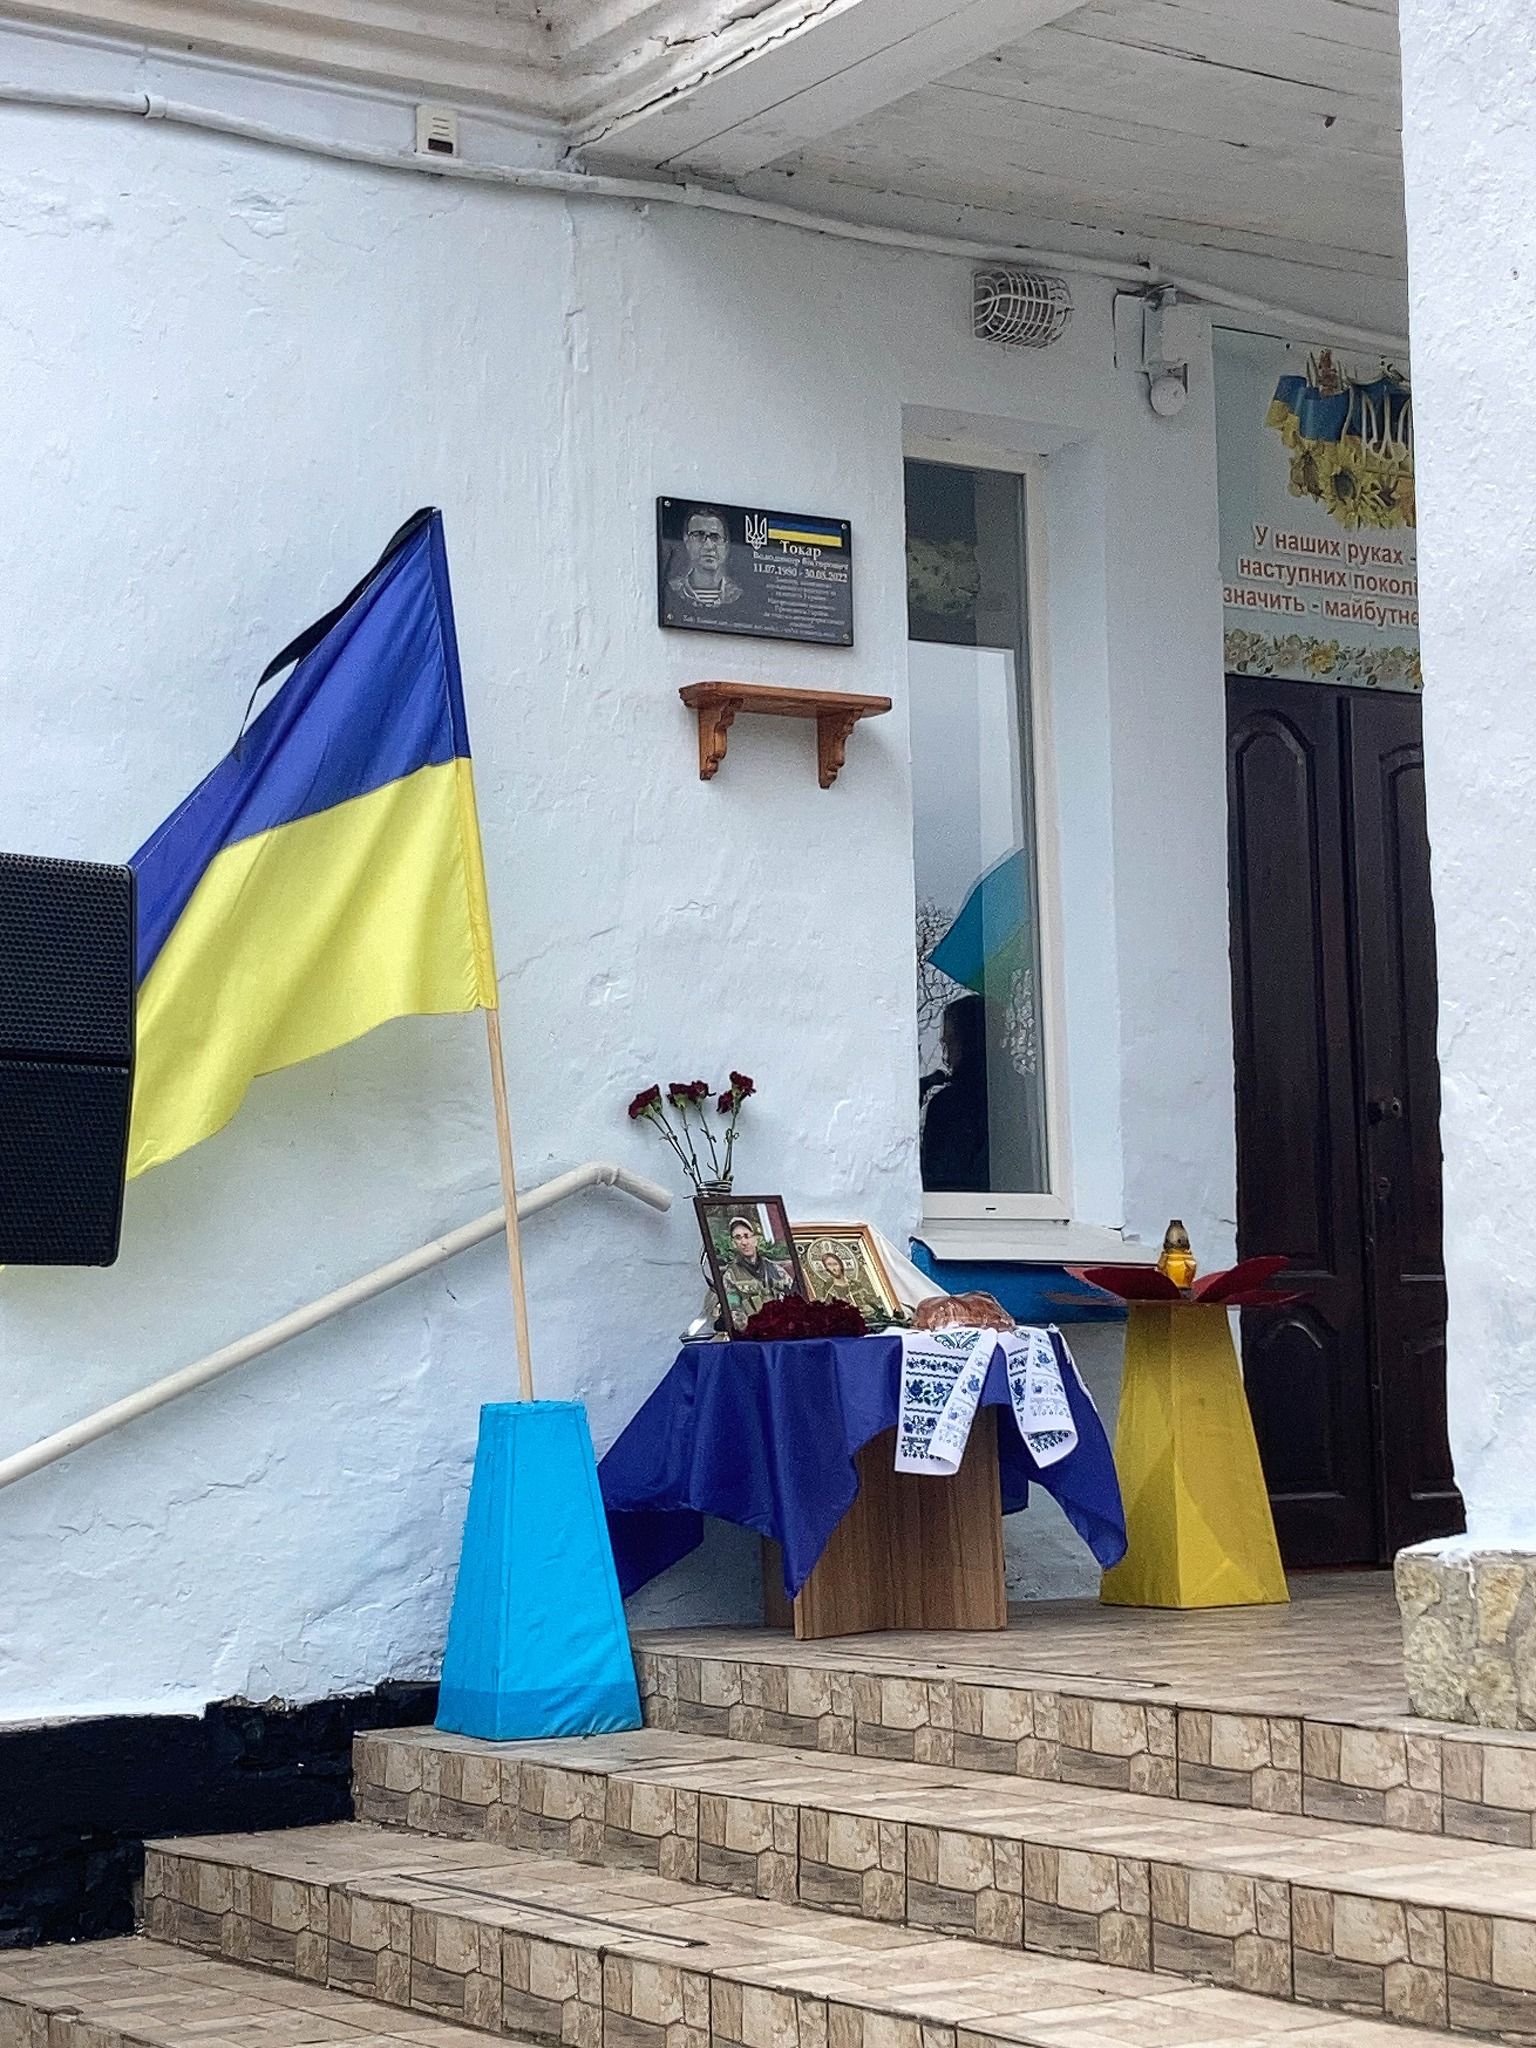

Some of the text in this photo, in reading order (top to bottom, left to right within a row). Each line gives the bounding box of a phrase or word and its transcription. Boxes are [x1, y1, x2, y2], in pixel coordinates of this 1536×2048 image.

[780, 540, 821, 560] Токар
[1255, 525, 1268, 546] У
[1275, 533, 1340, 556] наших
[1347, 543, 1402, 565] руках
[1239, 558, 1346, 587] наступних
[1223, 587, 1305, 612] значить
